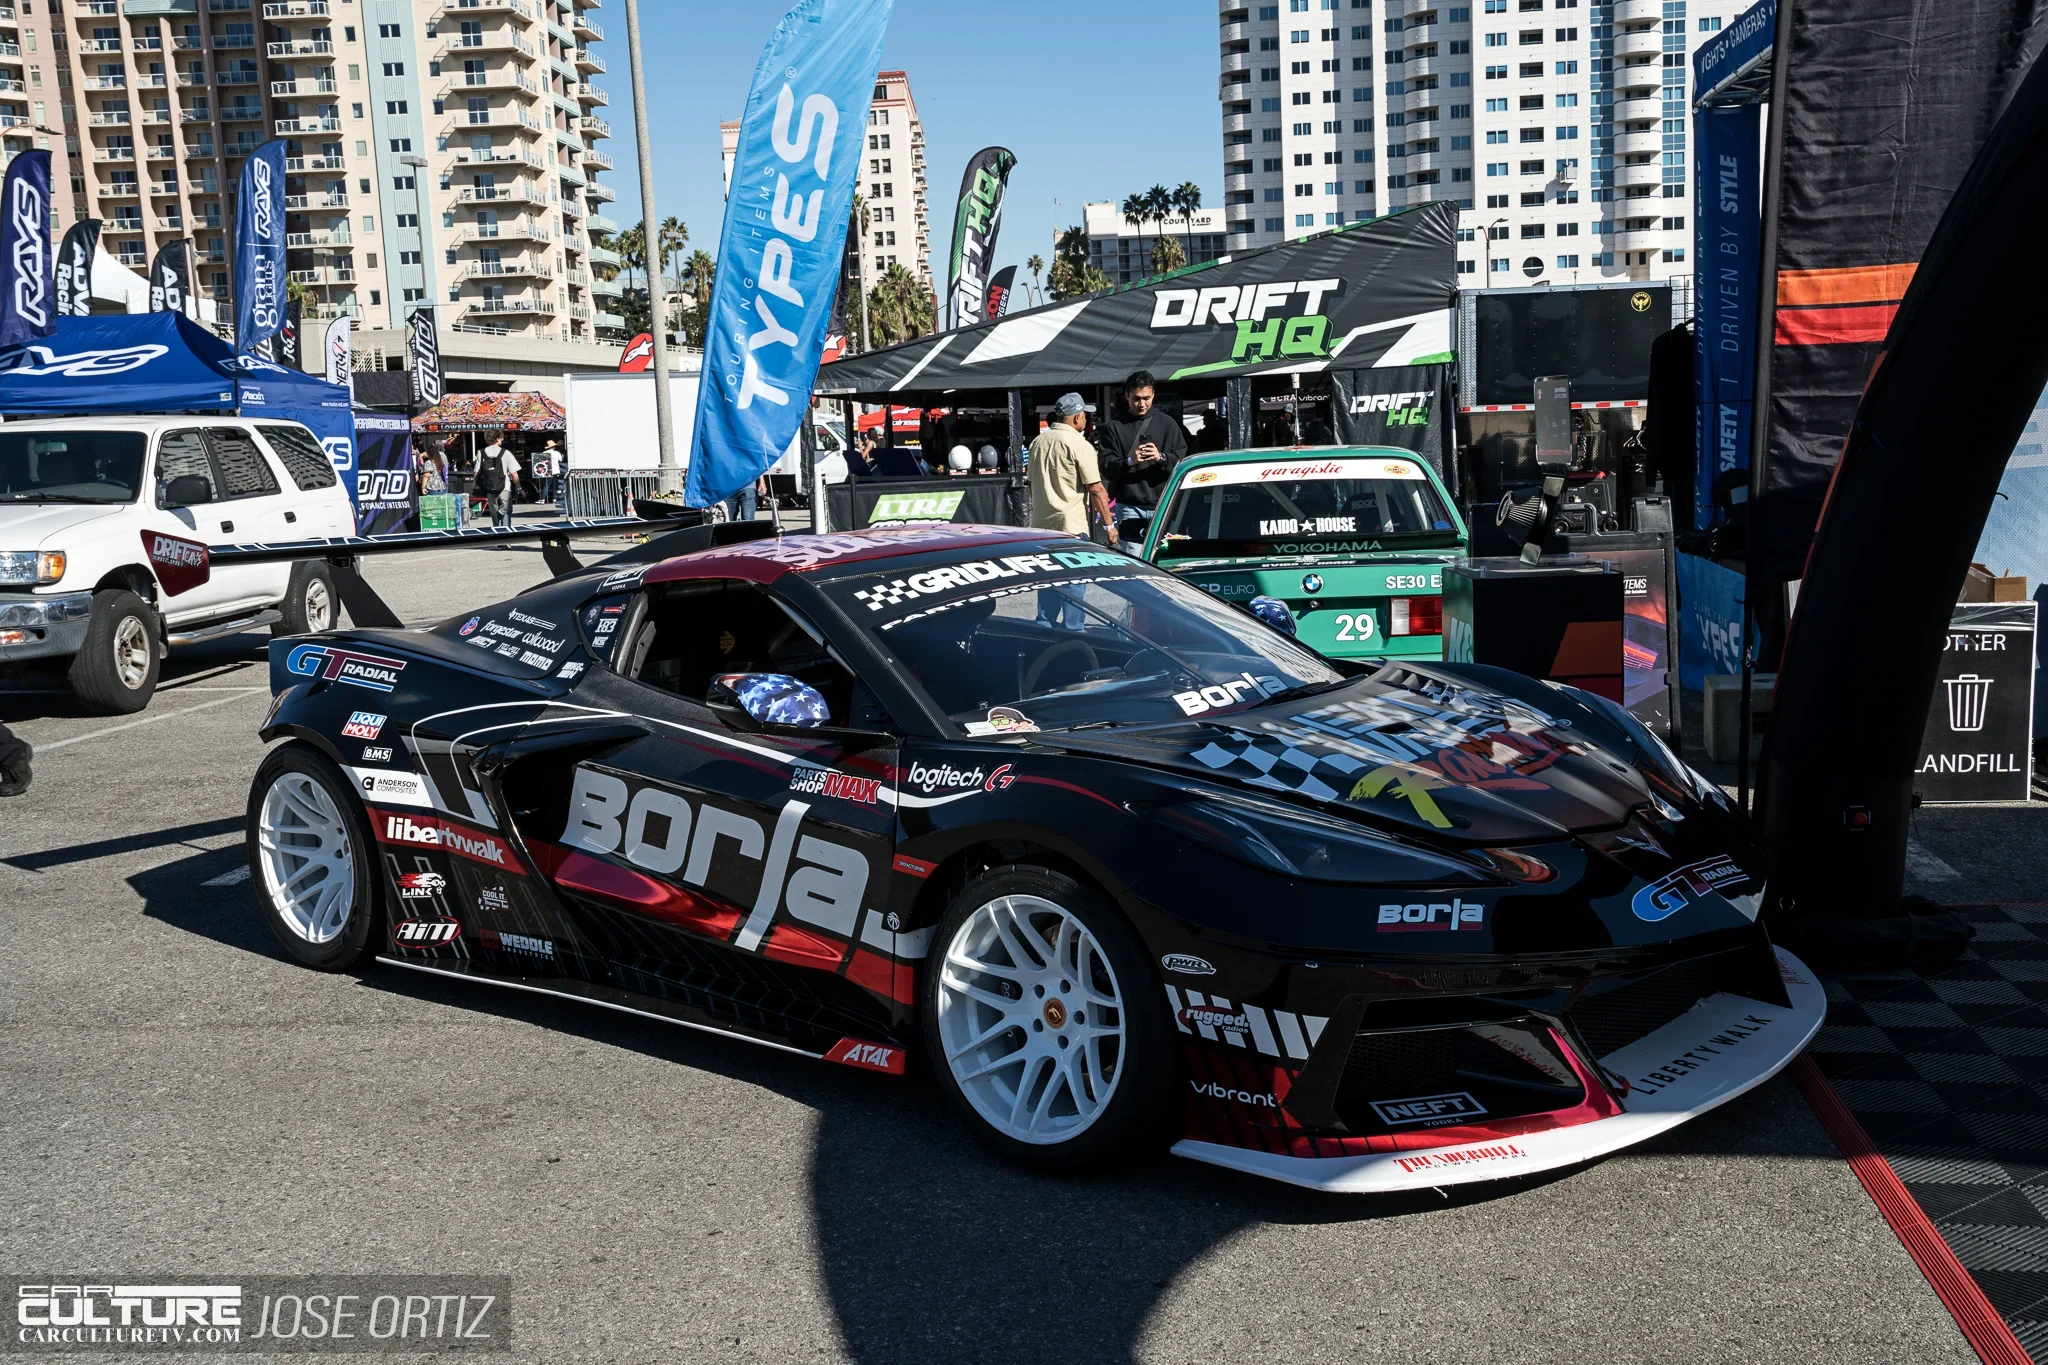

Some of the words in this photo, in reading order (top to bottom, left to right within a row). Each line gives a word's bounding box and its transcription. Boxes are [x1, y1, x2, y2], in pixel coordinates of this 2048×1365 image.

[1700, 40, 1726, 74] IGHTS
[1729, 7, 1766, 48] CAMERAS
[1720, 154, 1739, 214] STYLE
[253, 157, 271, 239] RAYS
[1163, 216, 1211, 225] COURYARD
[1720, 226, 1739, 255] BY
[13, 177, 46, 327] RAYS
[57, 262, 72, 316] Racin
[72, 241, 91, 316] ADV
[724, 276, 755, 404] TOURING
[749, 166, 775, 254] ITEMS
[1150, 278, 1343, 328] DRIFT
[1720, 267, 1739, 353] DRIVEN
[1231, 315, 1332, 362] HQ
[1351, 391, 1434, 414] DRIFT
[1386, 407, 1430, 428] HQ
[1720, 402, 1738, 473] SAFETY
[1258, 462, 1344, 480] garagistic
[878, 497, 957, 517] TIRE
[1259, 518, 1299, 535] KAIDO
[1315, 516, 1357, 533] HOUSE
[153, 535, 204, 561] DRIFT
[1273, 540, 1383, 553] YOKOHAMA
[907, 553, 1065, 594] GRIDLIFE
[1385, 574, 1426, 589] SE30
[1623, 578, 1647, 589] TEMS
[1223, 584, 1256, 595] EURO
[513, 610, 536, 625] TEXAS
[1334, 613, 1374, 641] 29
[479, 619, 524, 639] forgestar
[521, 631, 566, 653] wilwood
[343, 663, 398, 683] RADIAL
[351, 713, 383, 727] LIQUI
[344, 724, 379, 739] MOLY
[364, 748, 390, 761] BMS
[1914, 753, 2021, 773] ANDFILL
[377, 779, 418, 788] ANDERSON
[793, 767, 828, 782] PARTS
[907, 761, 984, 793] logitech
[376, 785, 417, 794] COMPOSITES
[789, 777, 824, 794] SHOP
[822, 772, 881, 805] MAX
[387, 816, 505, 864] libertywalk
[1700, 862, 1743, 882] RADIAL
[402, 887, 433, 897] LINK
[482, 889, 498, 899] COOL
[499, 932, 553, 954] WEDDLE
[1221, 1025, 1249, 1034] radios
[843, 1043, 894, 1068] ATAK
[1630, 1045, 1721, 1096] LIBERTY
[1708, 1014, 1772, 1046] WALK
[1189, 1080, 1278, 1108] vibrant
[1386, 1097, 1466, 1120] NEFT
[1423, 1117, 1464, 1128] VODKA
[1393, 1144, 1525, 1173] THUNDERHILL
[1415, 1158, 1480, 1171] RACEWAY
[1490, 1152, 1529, 1161] PARK
